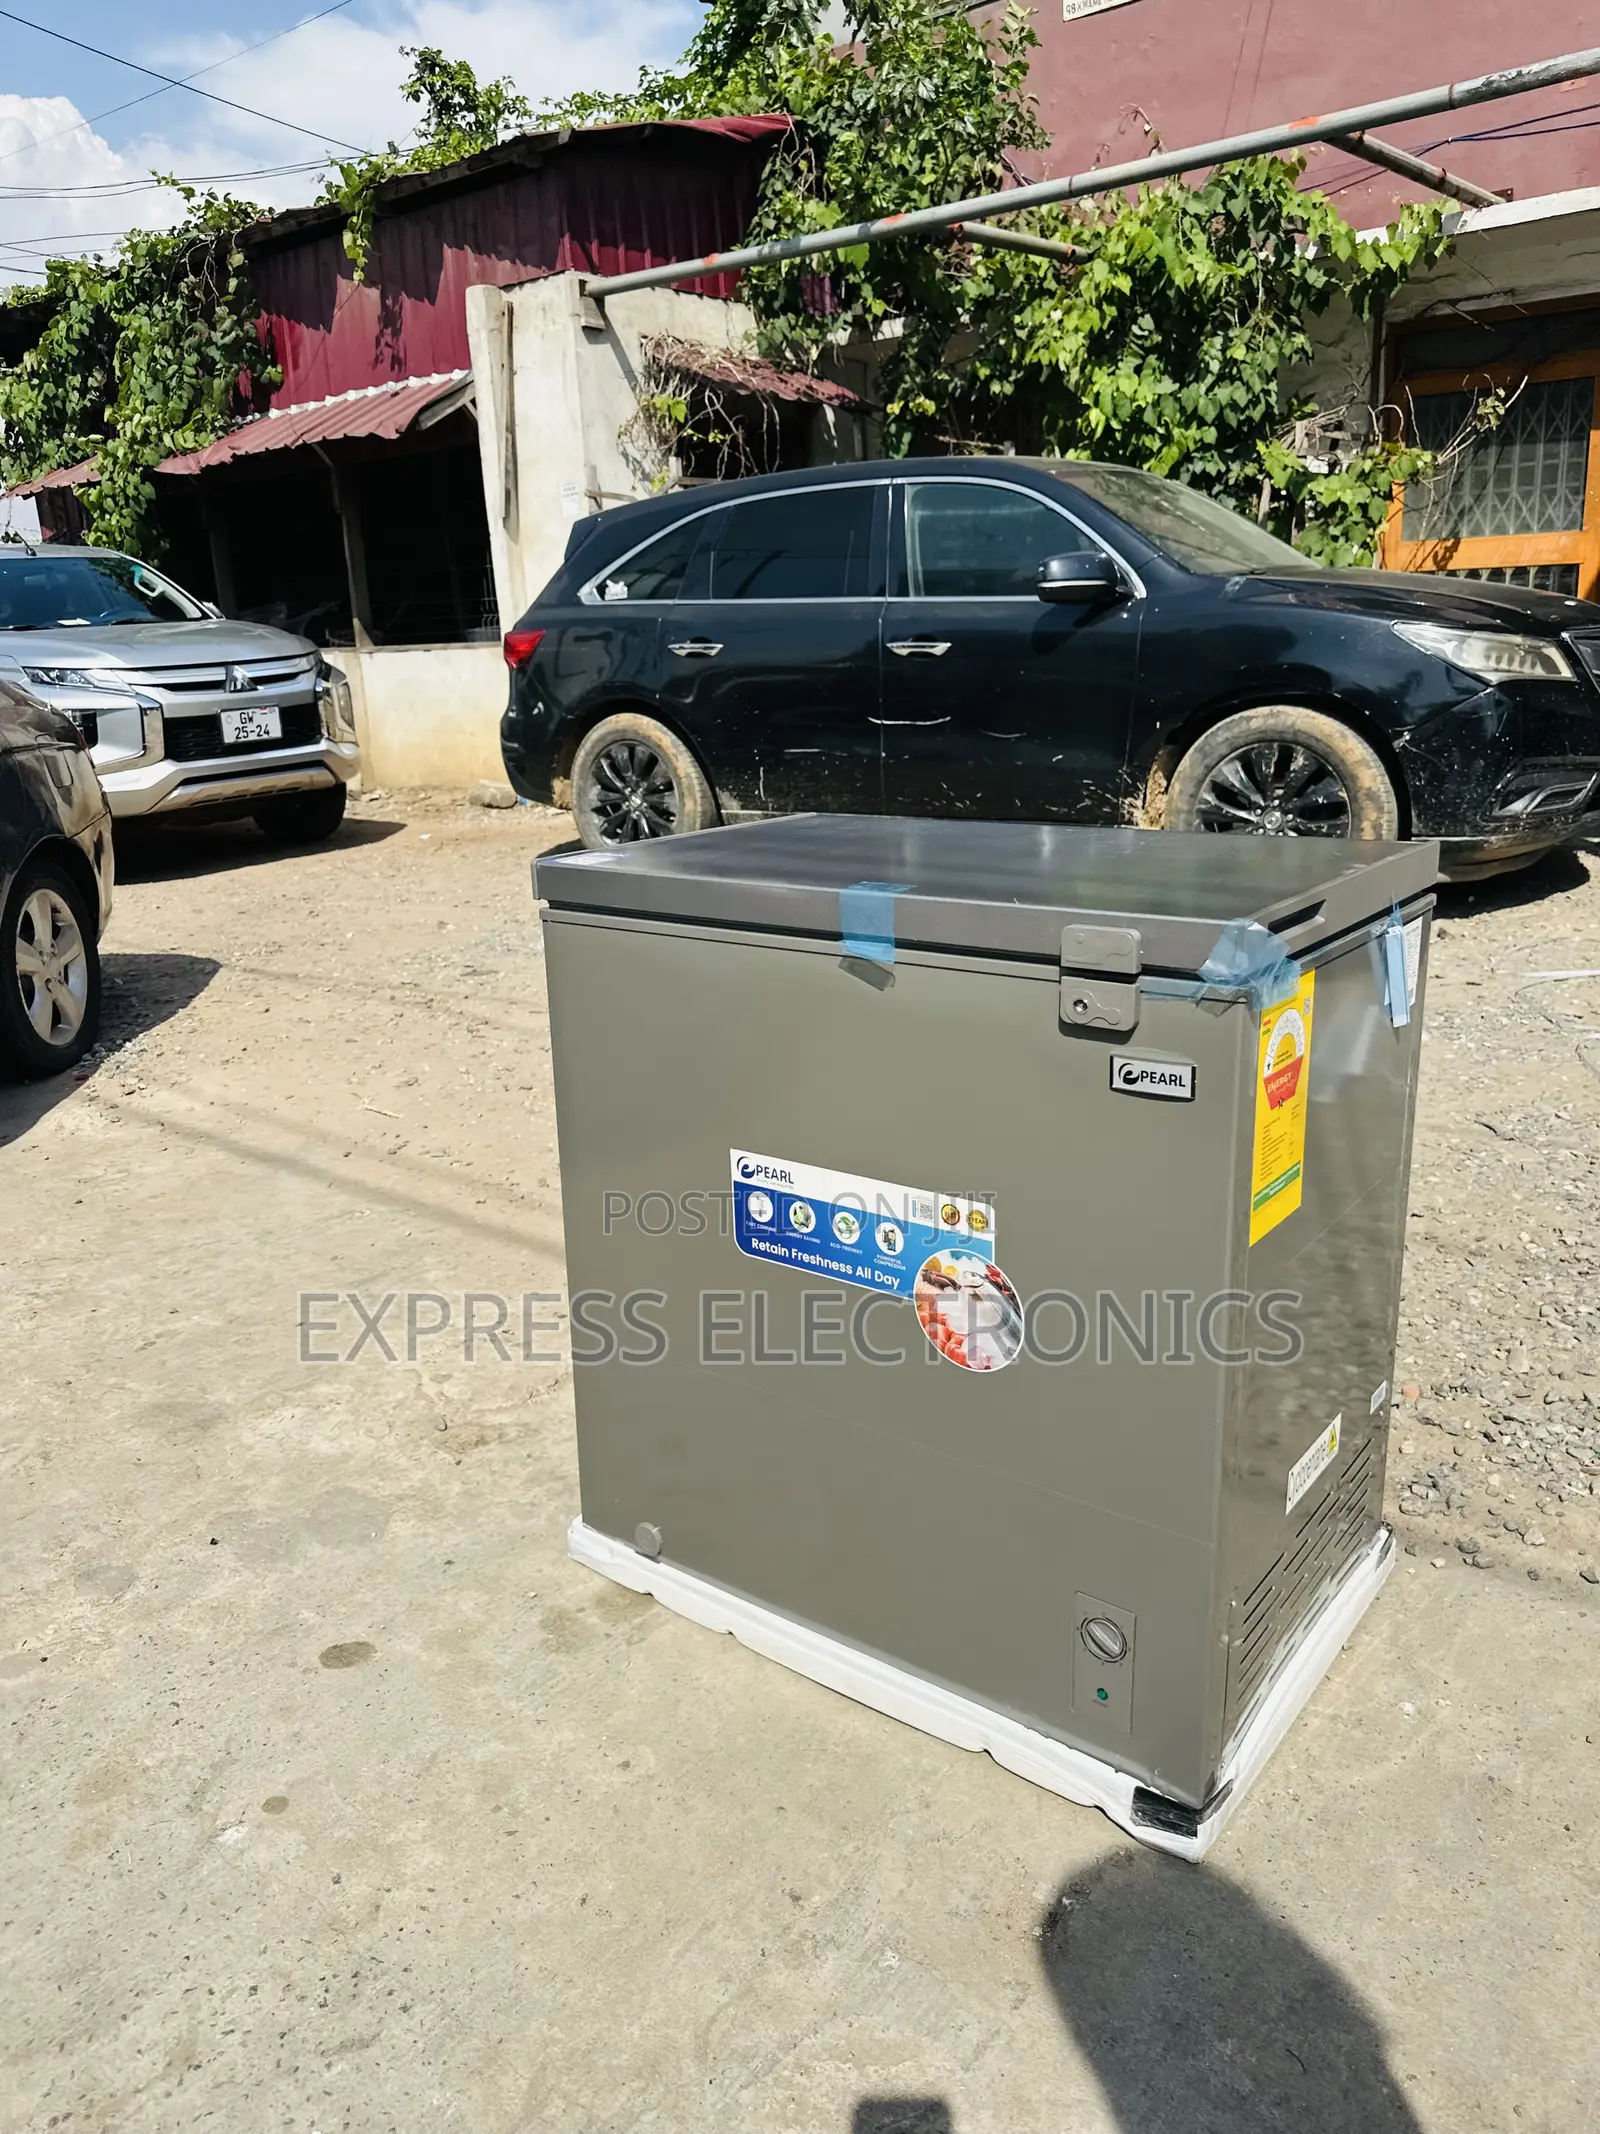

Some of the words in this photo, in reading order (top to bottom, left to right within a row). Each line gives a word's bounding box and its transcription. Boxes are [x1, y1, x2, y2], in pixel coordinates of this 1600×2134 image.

[240, 711, 254, 725] GW
[234, 723, 270, 740] 25-24
[751, 1237, 789, 1258] Retain
[791, 1247, 853, 1275] Freshness
[855, 1265, 872, 1280] All
[874, 1269, 900, 1290] Day
